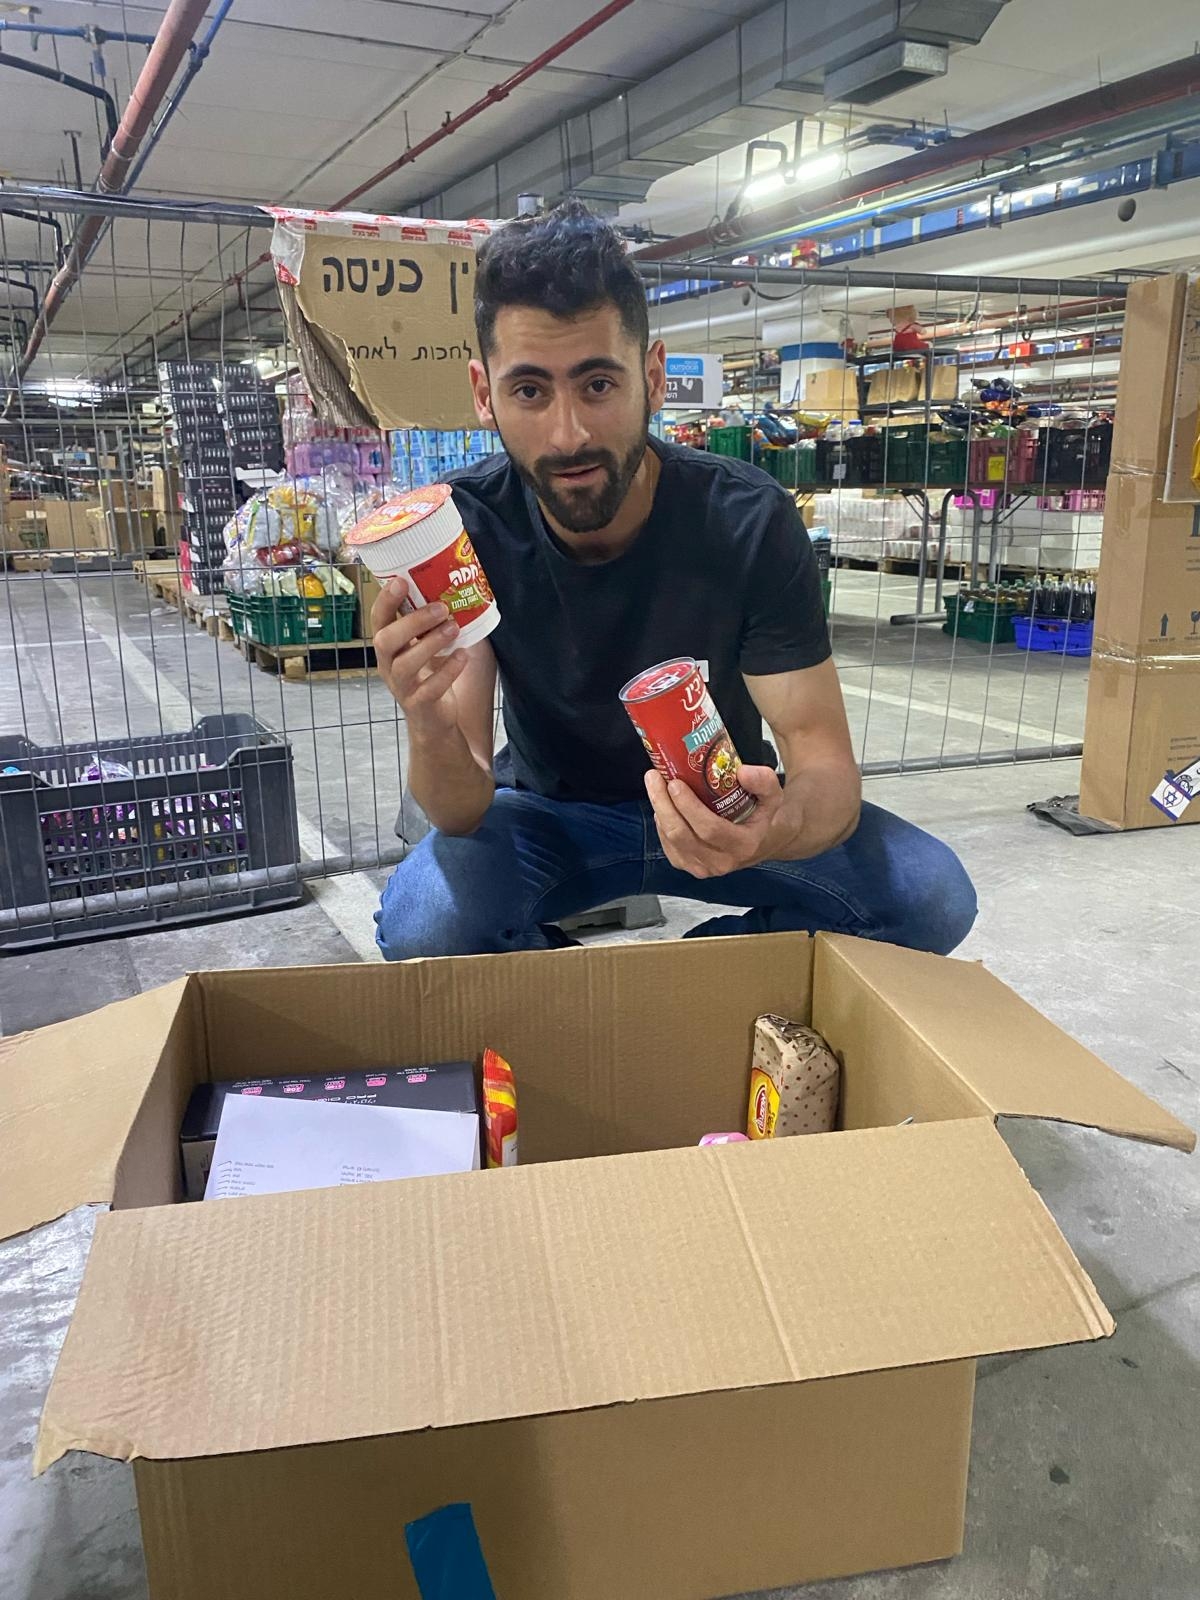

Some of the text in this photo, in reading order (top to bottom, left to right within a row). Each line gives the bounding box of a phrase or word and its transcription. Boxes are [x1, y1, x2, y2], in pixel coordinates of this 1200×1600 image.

[322, 256, 469, 315] ין כניסה
[410, 339, 472, 361] לחכות
[449, 565, 478, 586] חמה
[692, 716, 722, 745] קשוקה
